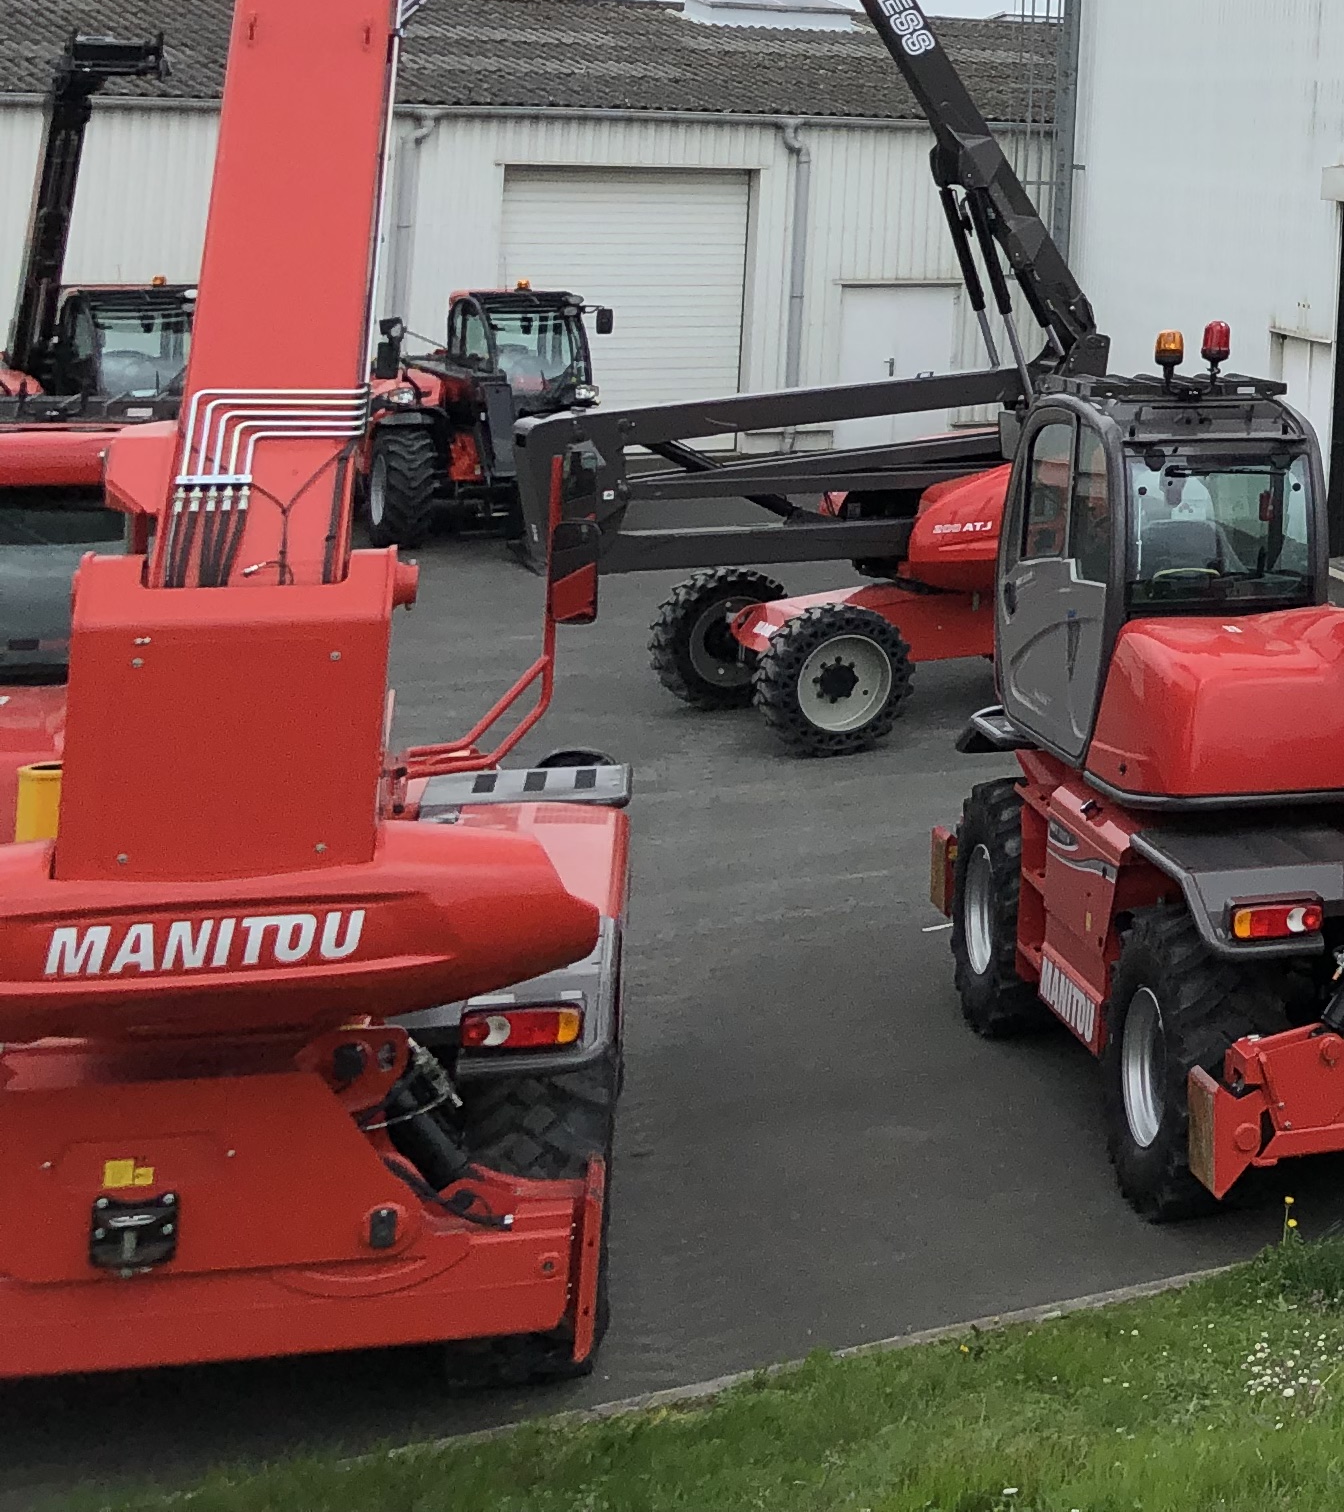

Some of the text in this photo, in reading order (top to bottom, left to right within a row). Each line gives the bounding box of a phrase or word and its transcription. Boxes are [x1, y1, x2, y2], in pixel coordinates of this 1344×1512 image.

[962, 520, 993, 532] ATJ
[43, 909, 366, 976] MANITOU
[1039, 955, 1096, 1043] MANITOU
